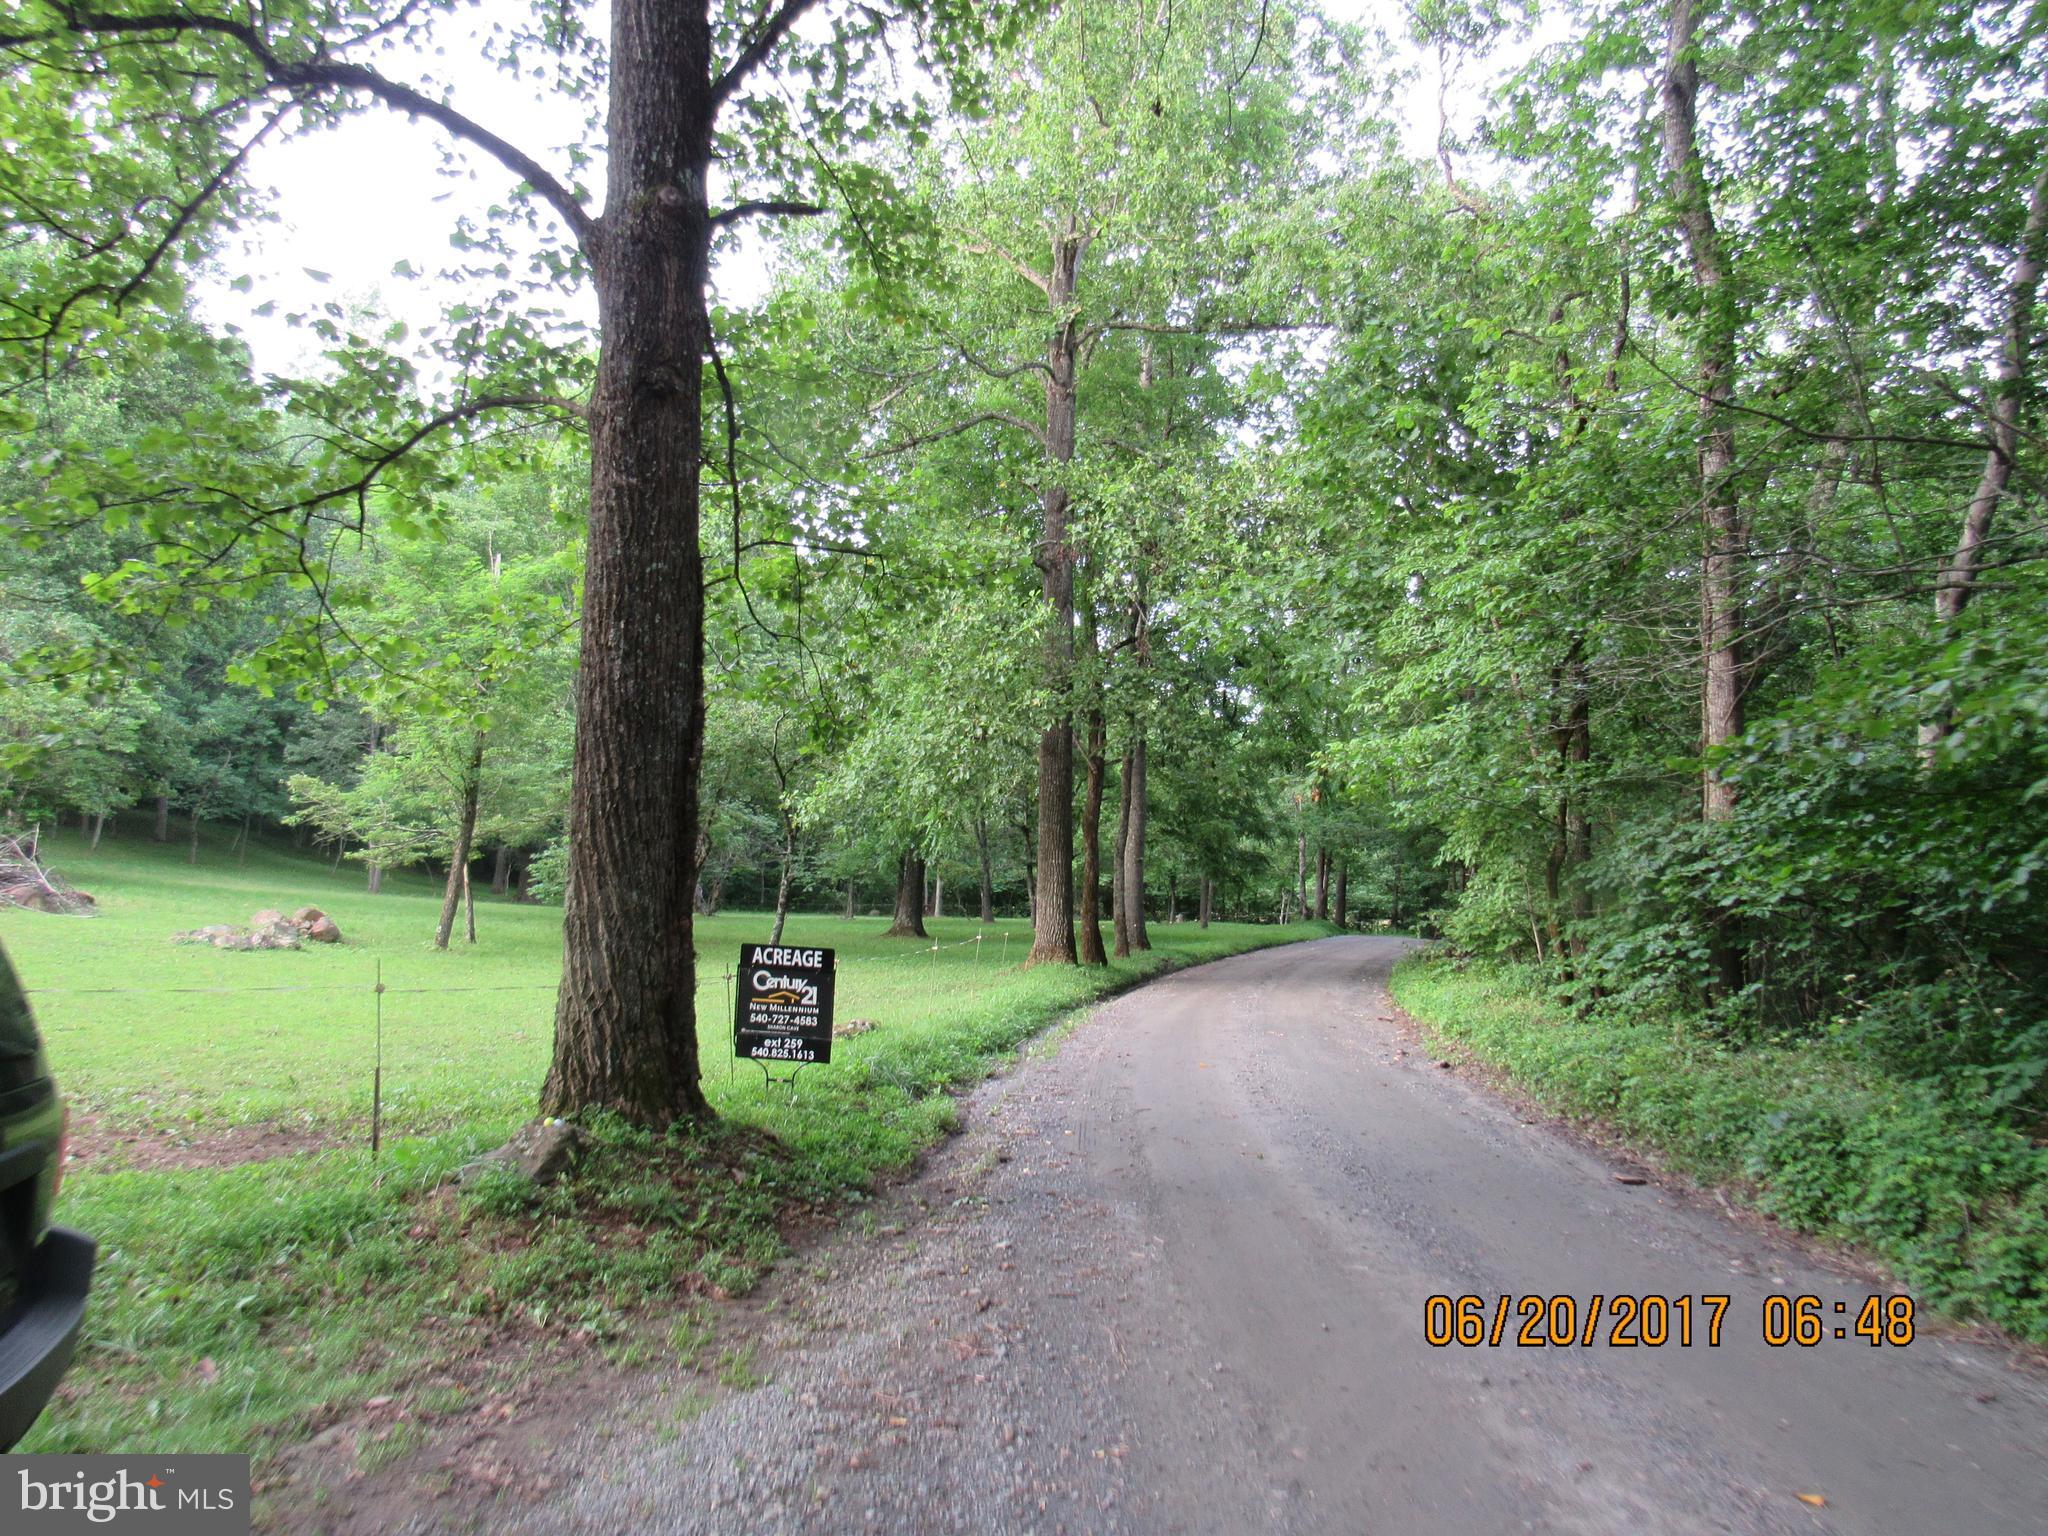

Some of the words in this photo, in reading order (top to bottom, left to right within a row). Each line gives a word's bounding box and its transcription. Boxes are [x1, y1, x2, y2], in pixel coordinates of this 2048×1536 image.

[753, 947, 823, 967] ACREAGE
[753, 970, 808, 992] Century
[802, 986, 818, 1005] 21
[750, 1014, 818, 1026] 540-727-4583
[764, 1037, 782, 1048] ext
[783, 1038, 803, 1049] 259
[751, 1047, 815, 1060] 540.825.1613
